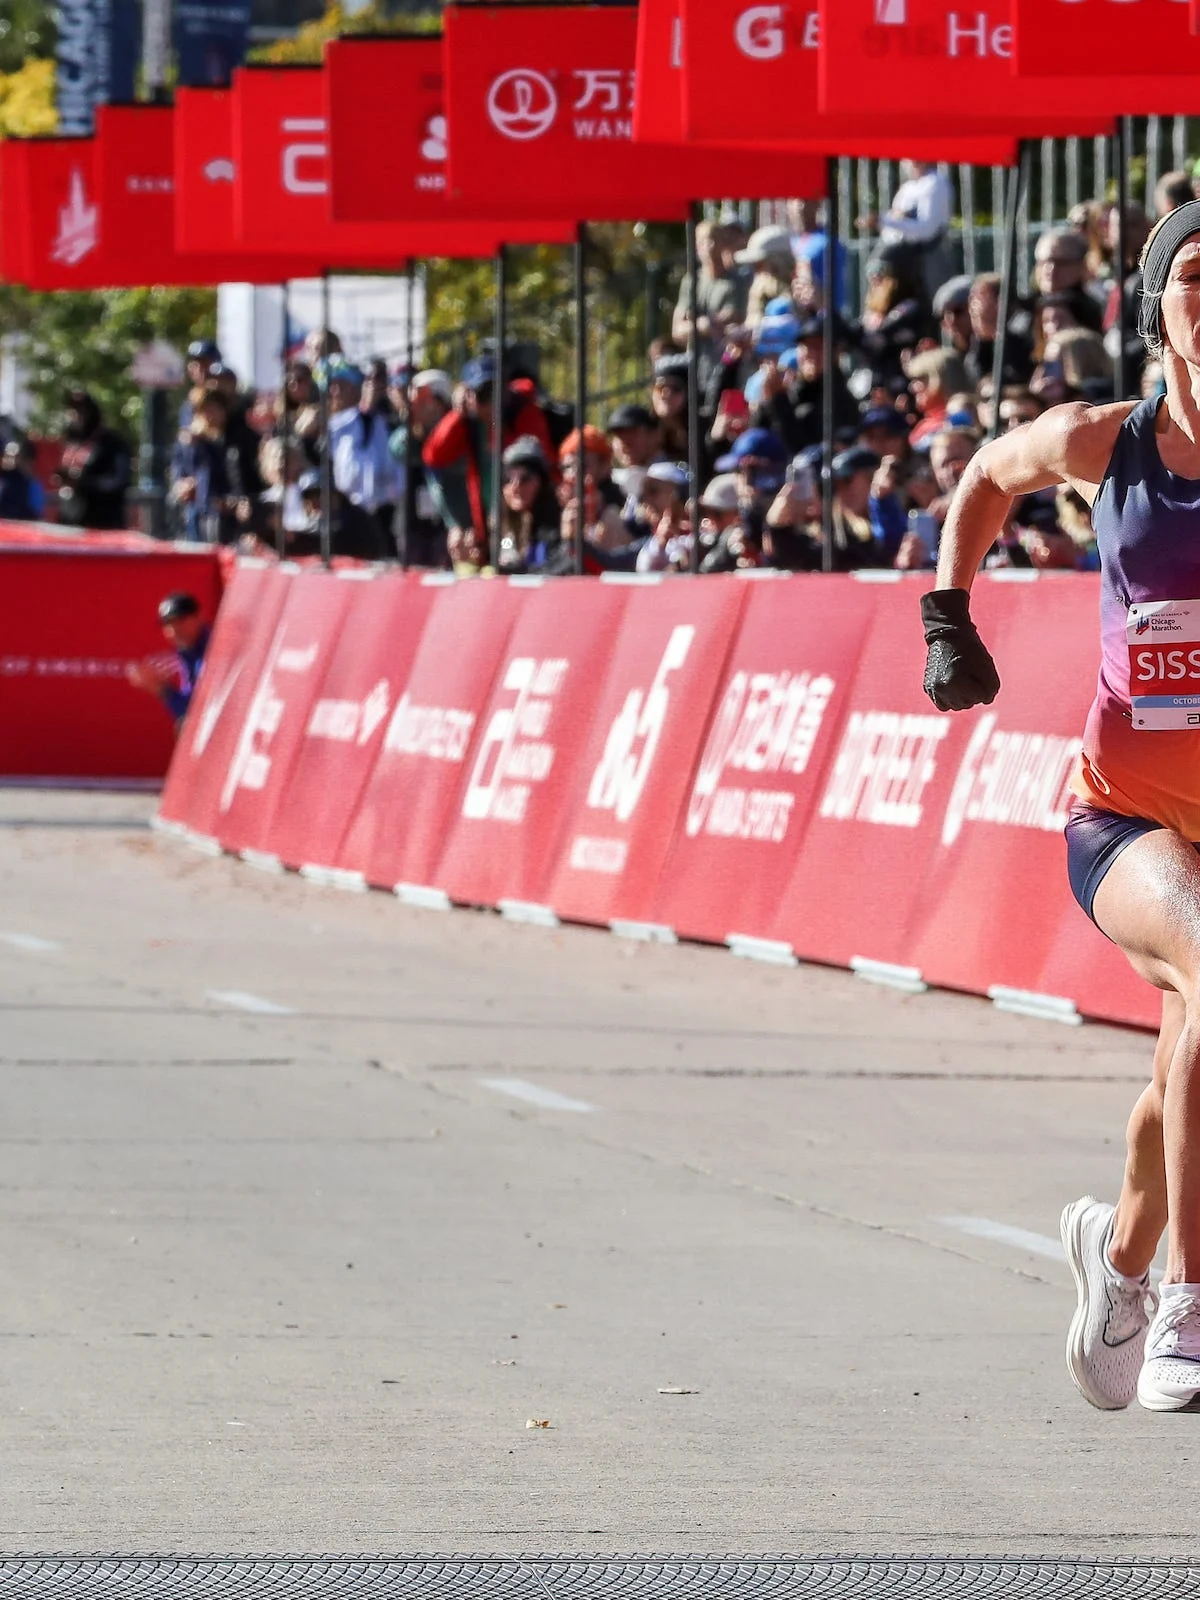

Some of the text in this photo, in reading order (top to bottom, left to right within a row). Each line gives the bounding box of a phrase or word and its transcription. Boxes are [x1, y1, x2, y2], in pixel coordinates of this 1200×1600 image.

[734, 5, 784, 59] G
[573, 69, 636, 110] 万
[1151, 618, 1176, 626] Chicago
